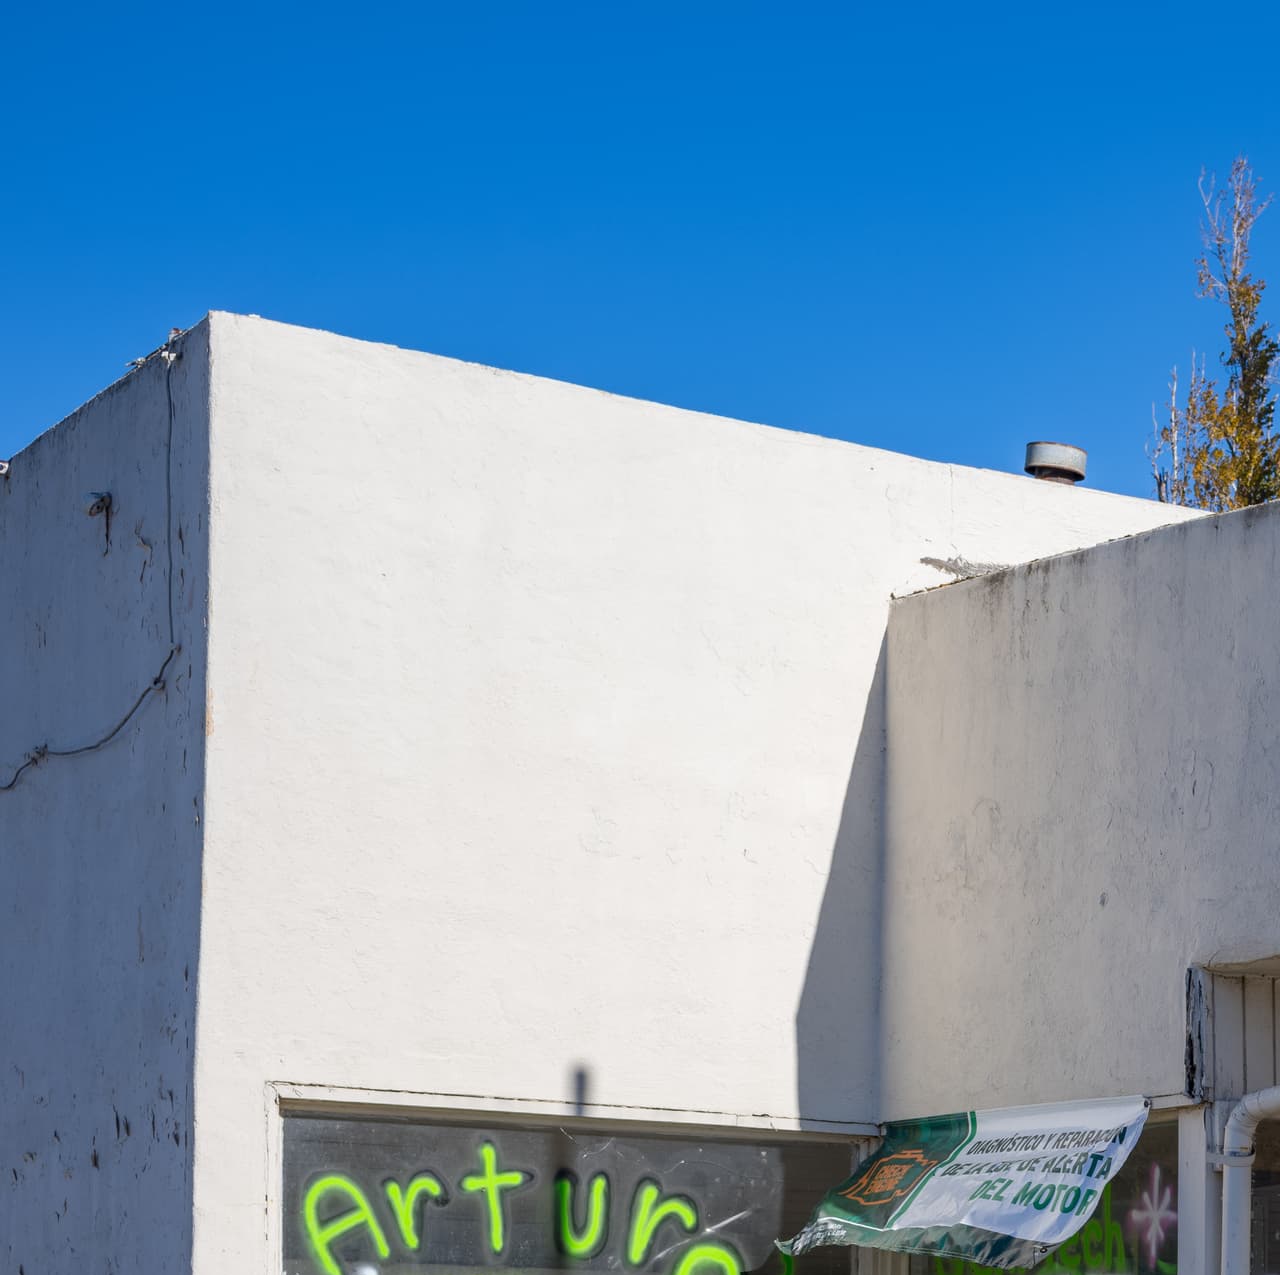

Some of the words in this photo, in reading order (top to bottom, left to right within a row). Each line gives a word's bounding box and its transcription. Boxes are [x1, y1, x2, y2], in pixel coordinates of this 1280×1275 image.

[965, 1132, 1046, 1156] DIAGNÓSTICO
[1043, 1133, 1057, 1150] Y
[1040, 1151, 1114, 1180] ALERTA
[968, 1178, 1010, 1202] DEL
[1011, 1181, 1099, 1217] MOTOR
